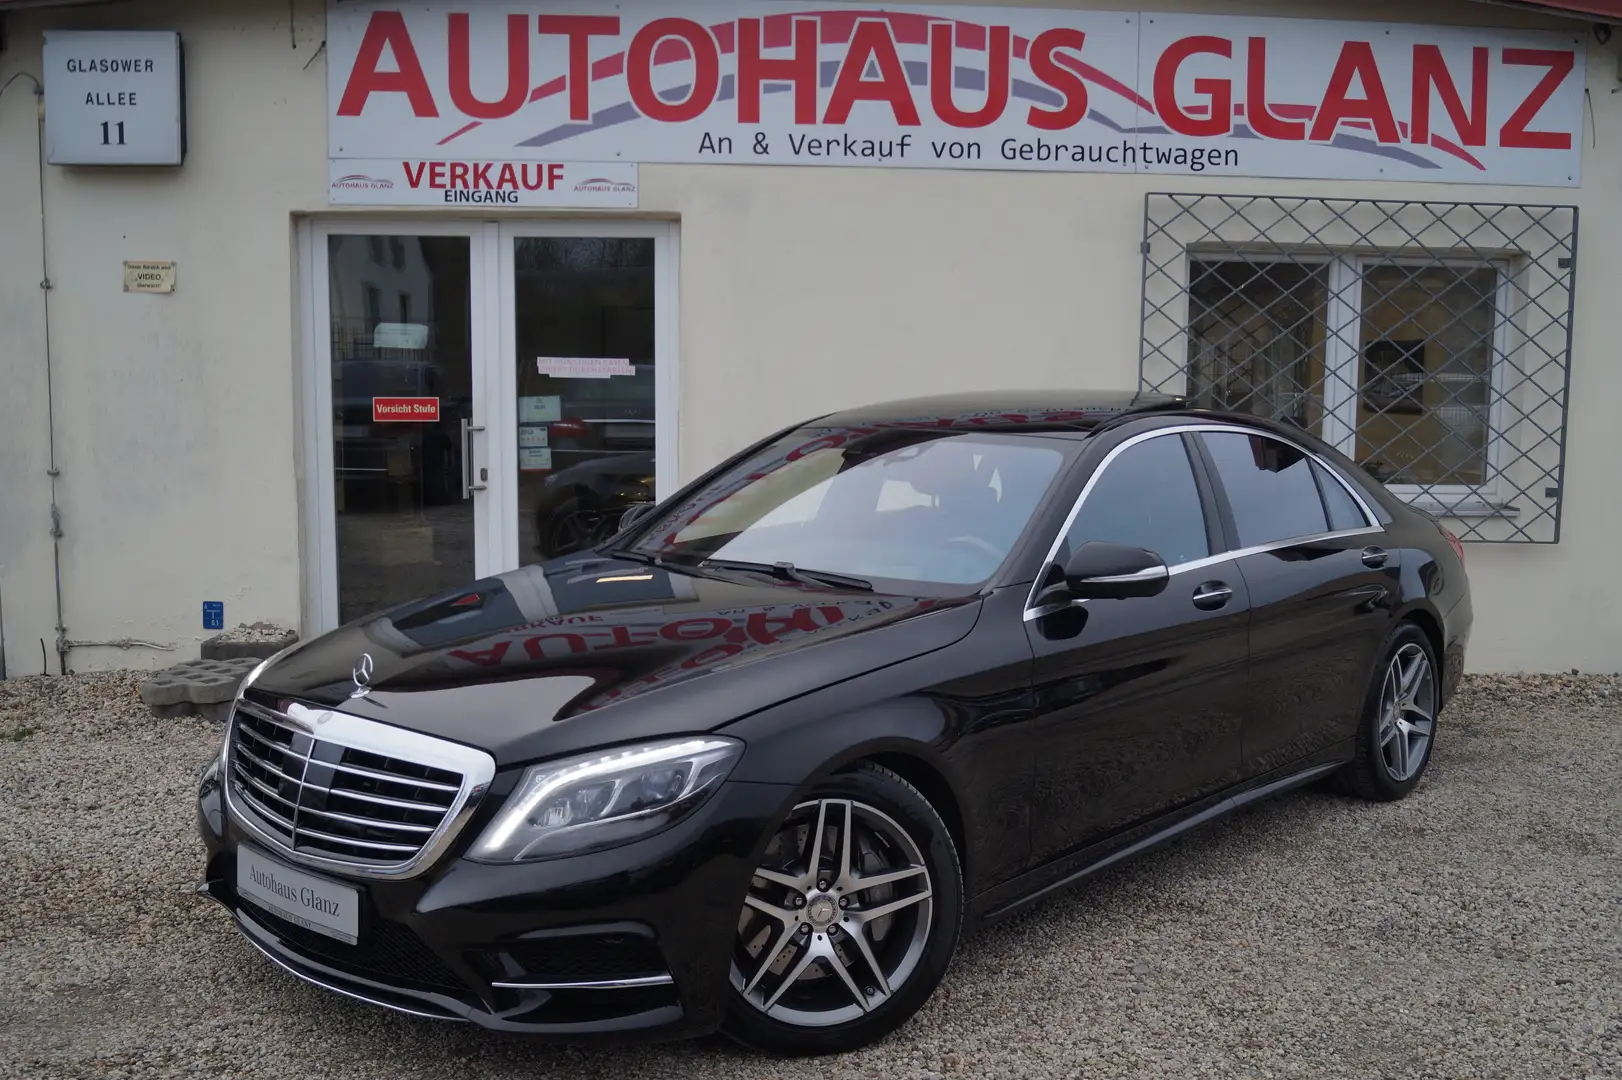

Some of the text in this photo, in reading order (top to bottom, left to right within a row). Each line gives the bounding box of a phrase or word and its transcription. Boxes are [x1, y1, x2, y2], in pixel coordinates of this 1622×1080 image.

[67, 58, 154, 73] GLASOWER
[336, 10, 1574, 149] AUTOHAUS GLANZ
[85, 92, 137, 106] ALLEE
[100, 120, 127, 145] 11
[698, 131, 1239, 171] An & Verkauf von Gebrauchtwagen
[402, 161, 564, 191] VERKAUF
[444, 190, 518, 203] EINGANG
[376, 404, 436, 414] Vorsicht Stufe
[249, 865, 340, 918] Autohaus Glanz
